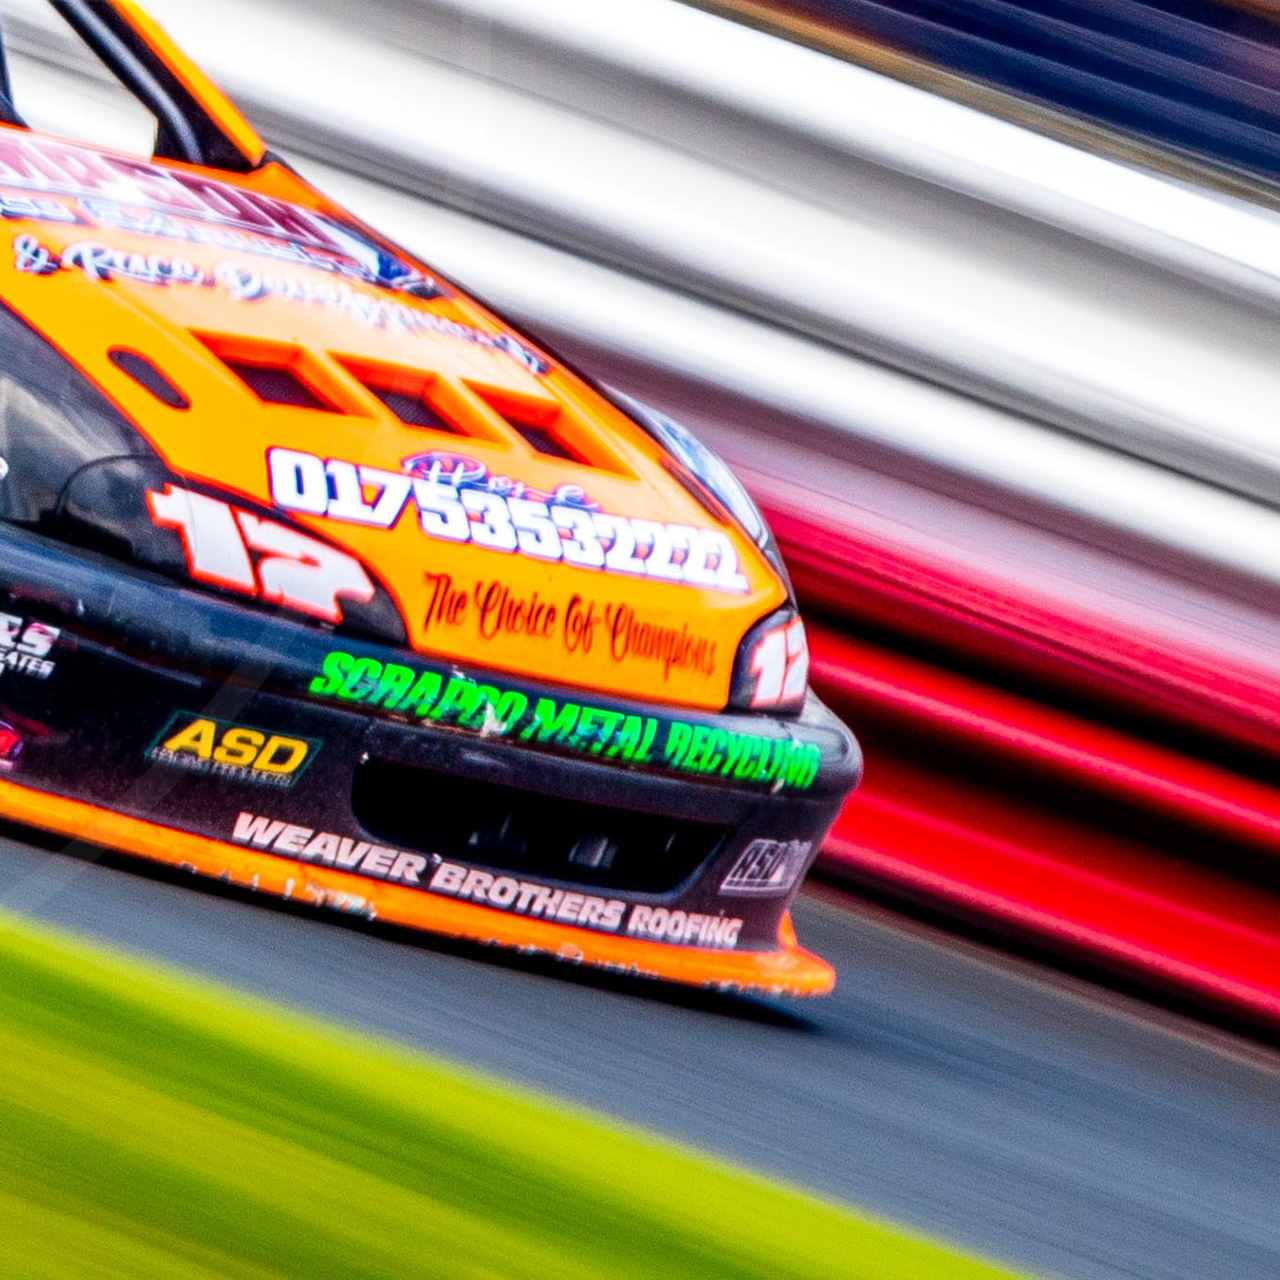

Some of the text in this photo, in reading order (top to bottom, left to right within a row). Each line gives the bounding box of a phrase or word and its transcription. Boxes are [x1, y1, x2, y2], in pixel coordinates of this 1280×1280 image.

[13, 234, 53, 275] &
[147, 481, 377, 626] 17
[266, 446, 751, 594] 01753532222
[423, 571, 468, 634] The
[474, 580, 557, 640] Choice
[604, 602, 720, 681] Champions
[748, 615, 810, 710] 17
[163, 718, 310, 775] ASD
[308, 650, 823, 791] SCRAPCO METAL RECYCLING
[231, 811, 745, 949] WEAVER BROTHERS ROOFING
